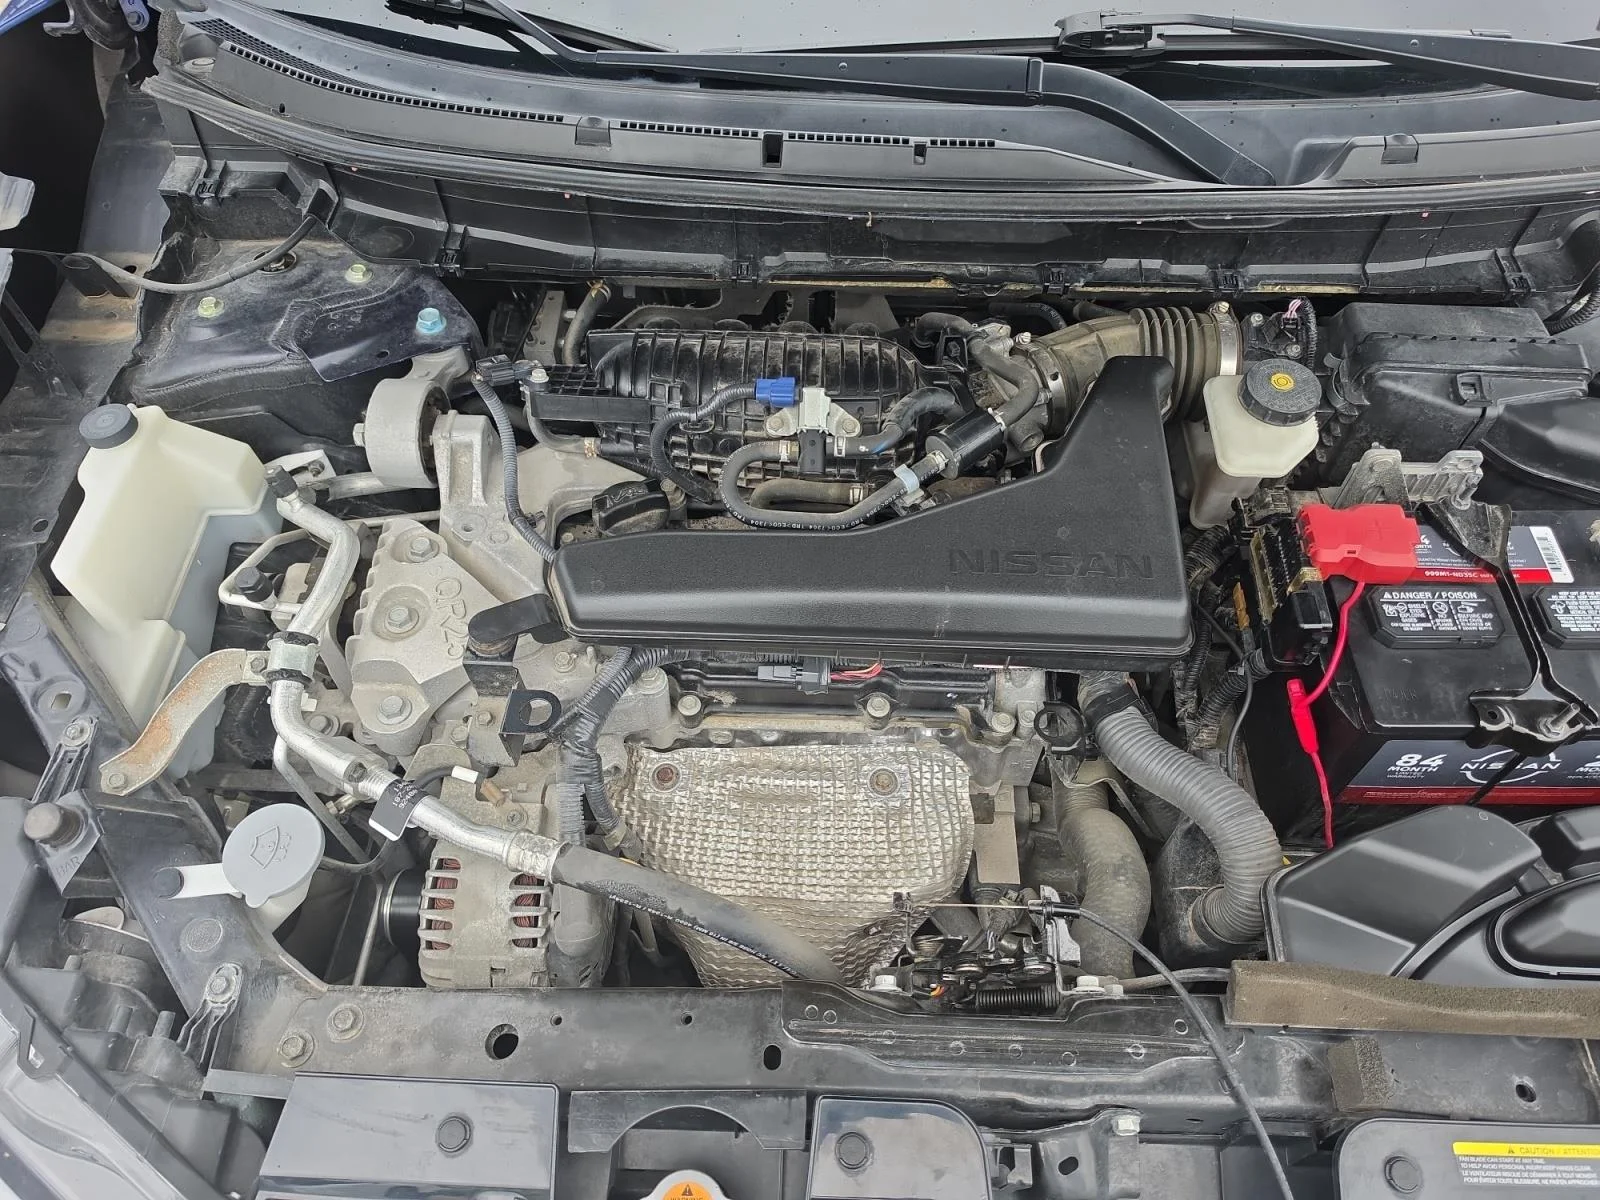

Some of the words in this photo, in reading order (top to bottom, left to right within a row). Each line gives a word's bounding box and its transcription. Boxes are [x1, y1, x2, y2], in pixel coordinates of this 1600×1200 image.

[948, 549, 1156, 581] NISSAN
[1395, 753, 1448, 767] 84
[1519, 1146, 1555, 1156] CAUTION
